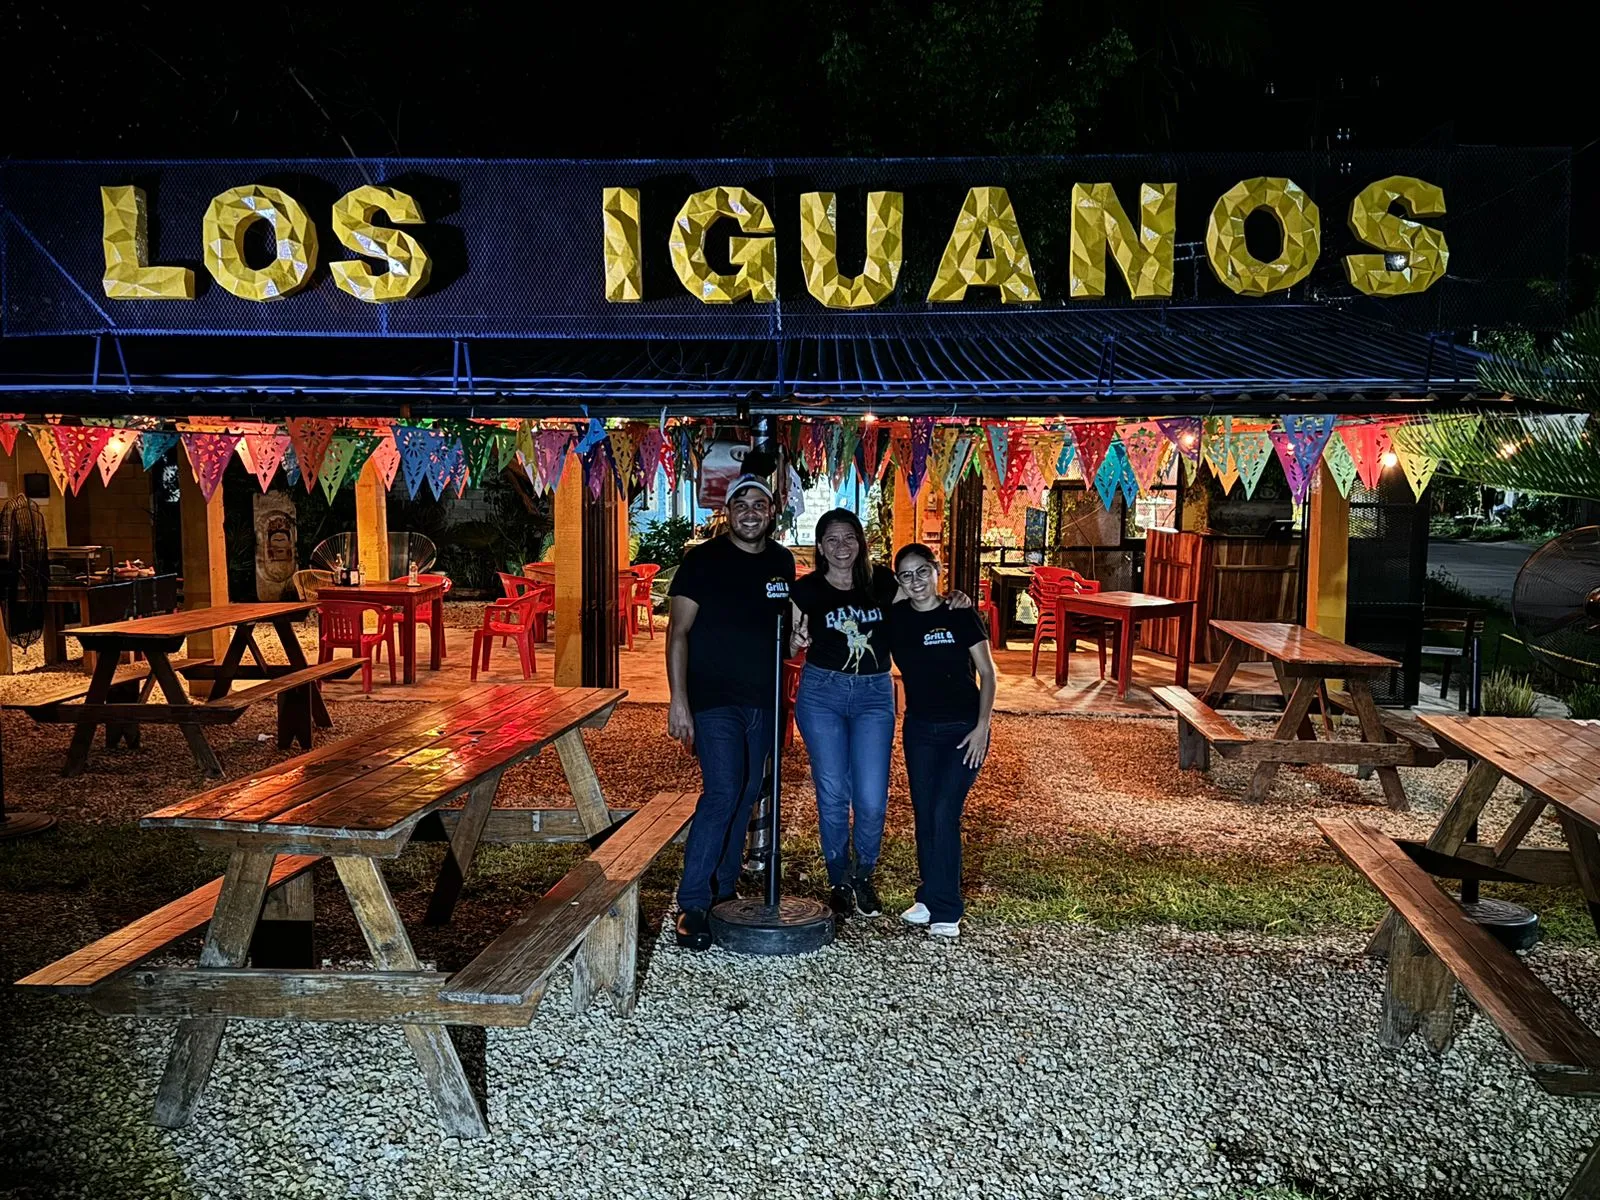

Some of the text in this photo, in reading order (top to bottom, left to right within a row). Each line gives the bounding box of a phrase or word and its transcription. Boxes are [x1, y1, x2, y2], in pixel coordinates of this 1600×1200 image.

[100, 175, 1450, 309] LOS IGUANOS
[765, 582, 785, 592] Grill
[824, 605, 883, 628] BAMBI
[923, 631, 954, 641] Grill &
